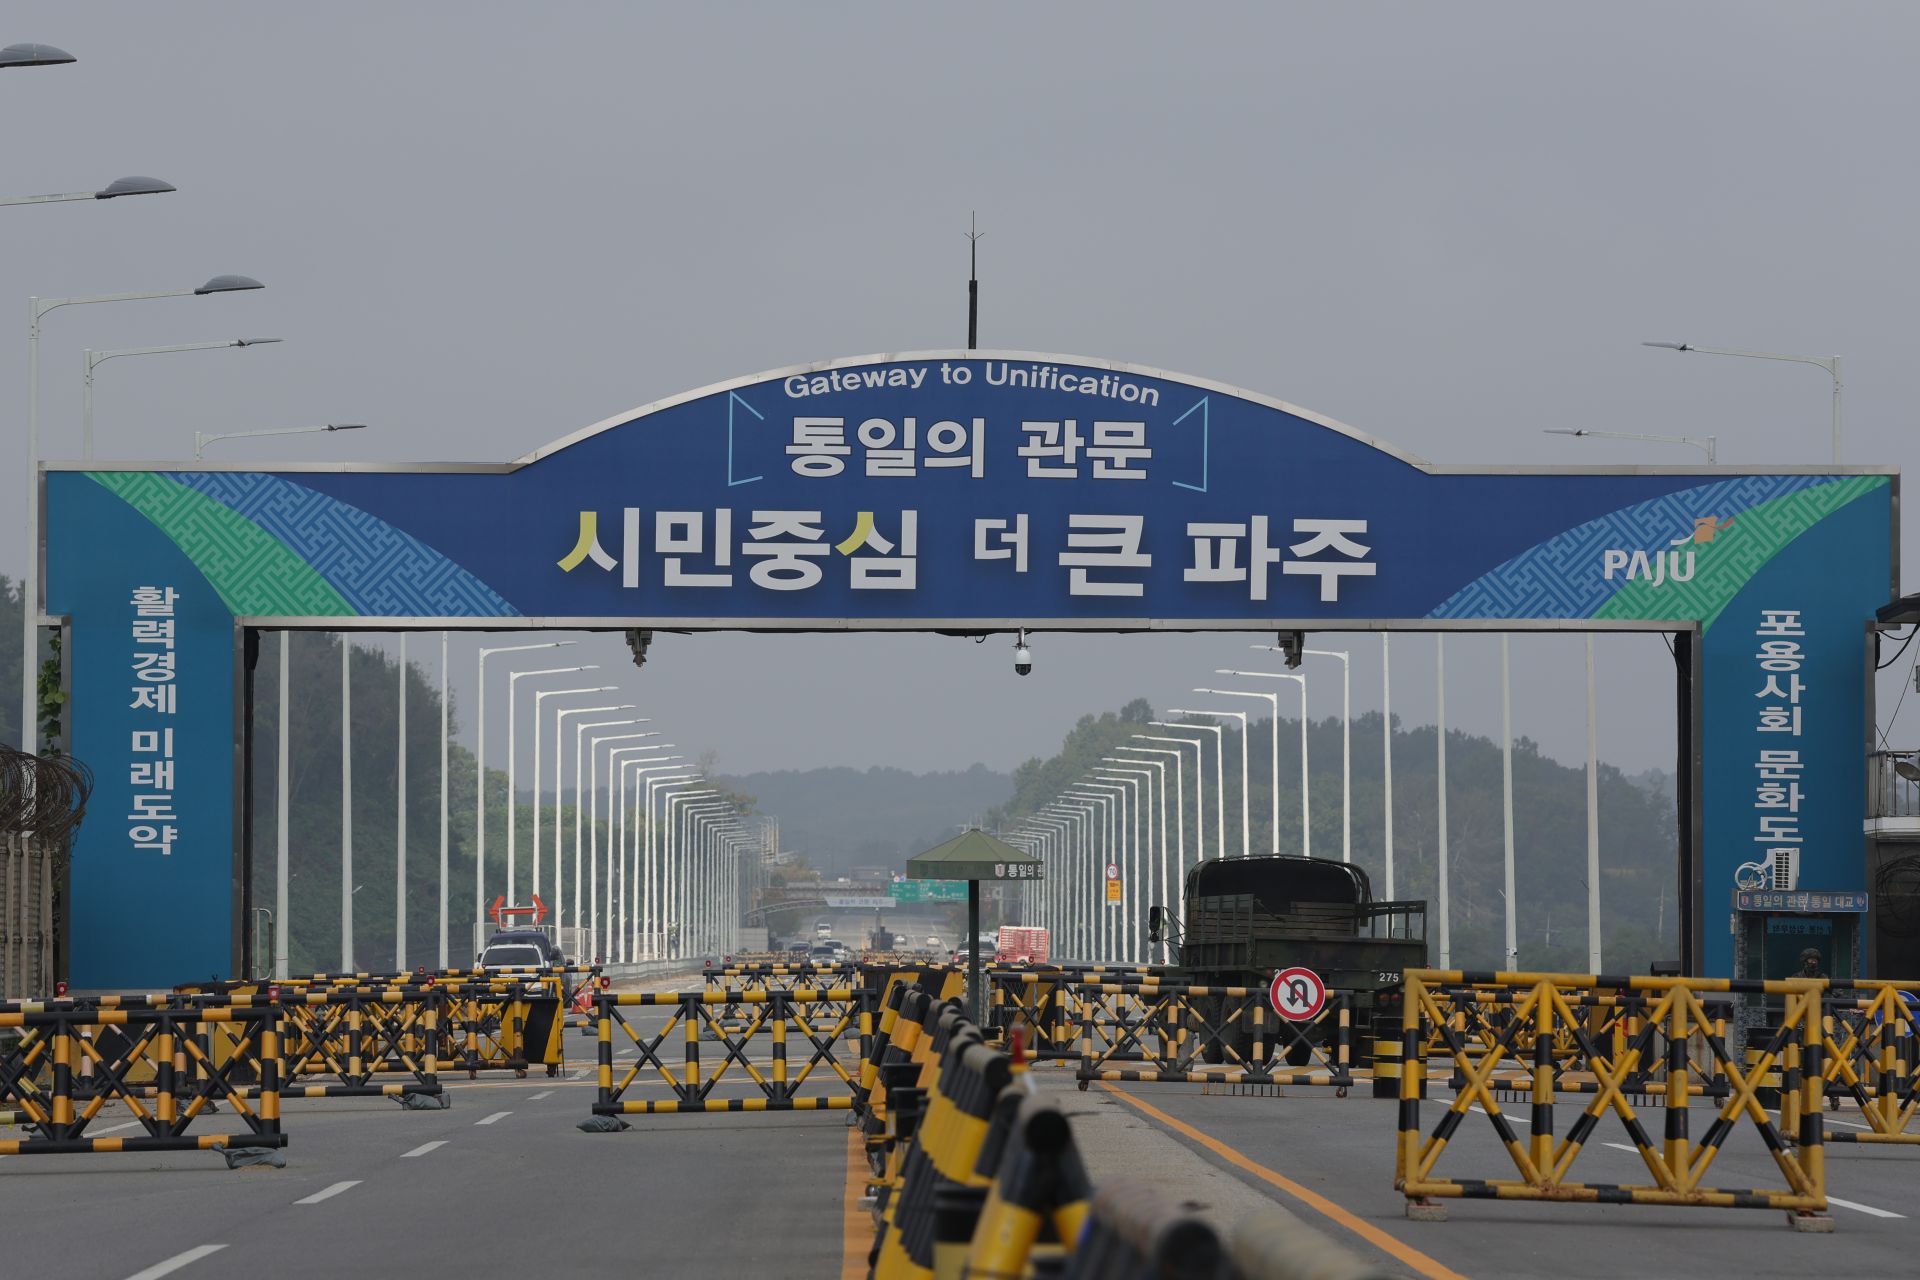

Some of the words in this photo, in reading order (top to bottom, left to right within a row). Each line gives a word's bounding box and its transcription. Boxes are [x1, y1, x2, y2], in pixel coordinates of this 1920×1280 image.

[783, 366, 928, 399] Gateway
[941, 365, 972, 385] to
[985, 362, 1160, 407] Unification
[785, 416, 985, 478] 통일의
[1017, 419, 1152, 480] 관문
[557, 508, 918, 591] 시민중심
[974, 513, 1029, 573] 더
[1058, 513, 1153, 597] 큰
[1183, 515, 1377, 602] 파주
[1603, 549, 1696, 588] PAJU
[129, 586, 180, 714] 활력경제
[1754, 609, 1806, 736] 포용사회
[128, 727, 178, 855] 미래도약
[1007, 863, 1034, 878] 통일의
[1753, 894, 1783, 908] 통일의
[1810, 895, 1832, 909] 통일
[1835, 895, 1854, 909] 대교
[1379, 972, 1399, 983] 275
